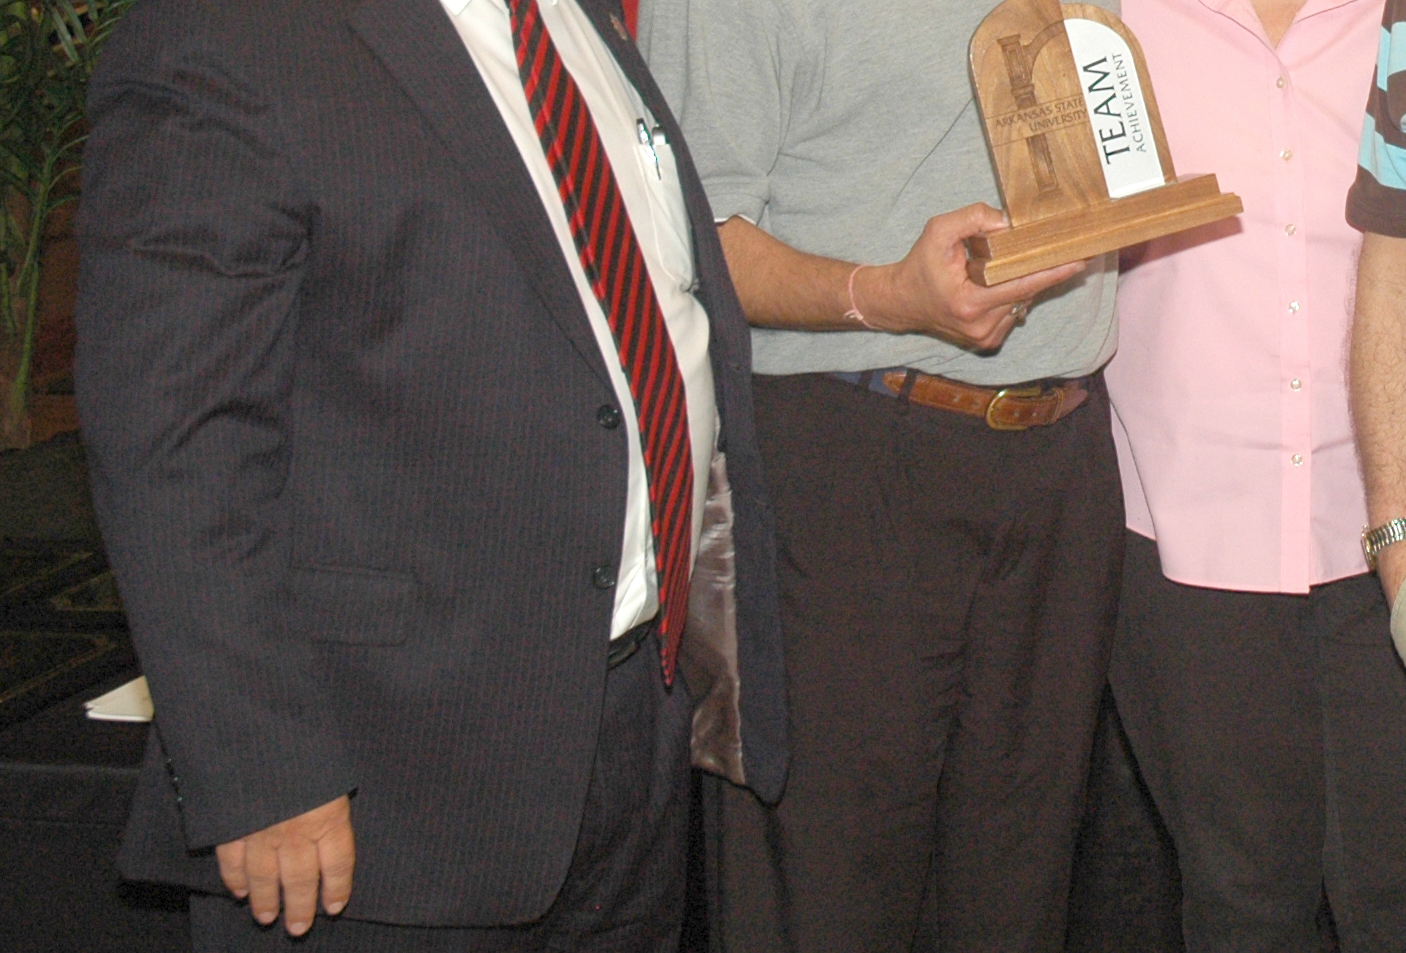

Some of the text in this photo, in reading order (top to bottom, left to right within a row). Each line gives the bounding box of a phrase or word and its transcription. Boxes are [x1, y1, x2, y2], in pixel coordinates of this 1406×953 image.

[995, 105, 1054, 128] ARKANSAS
[1028, 108, 1089, 133] UNIVERSITY
[1082, 55, 1131, 165] TEAM
[1111, 52, 1147, 154] ACHIEVEMENT
